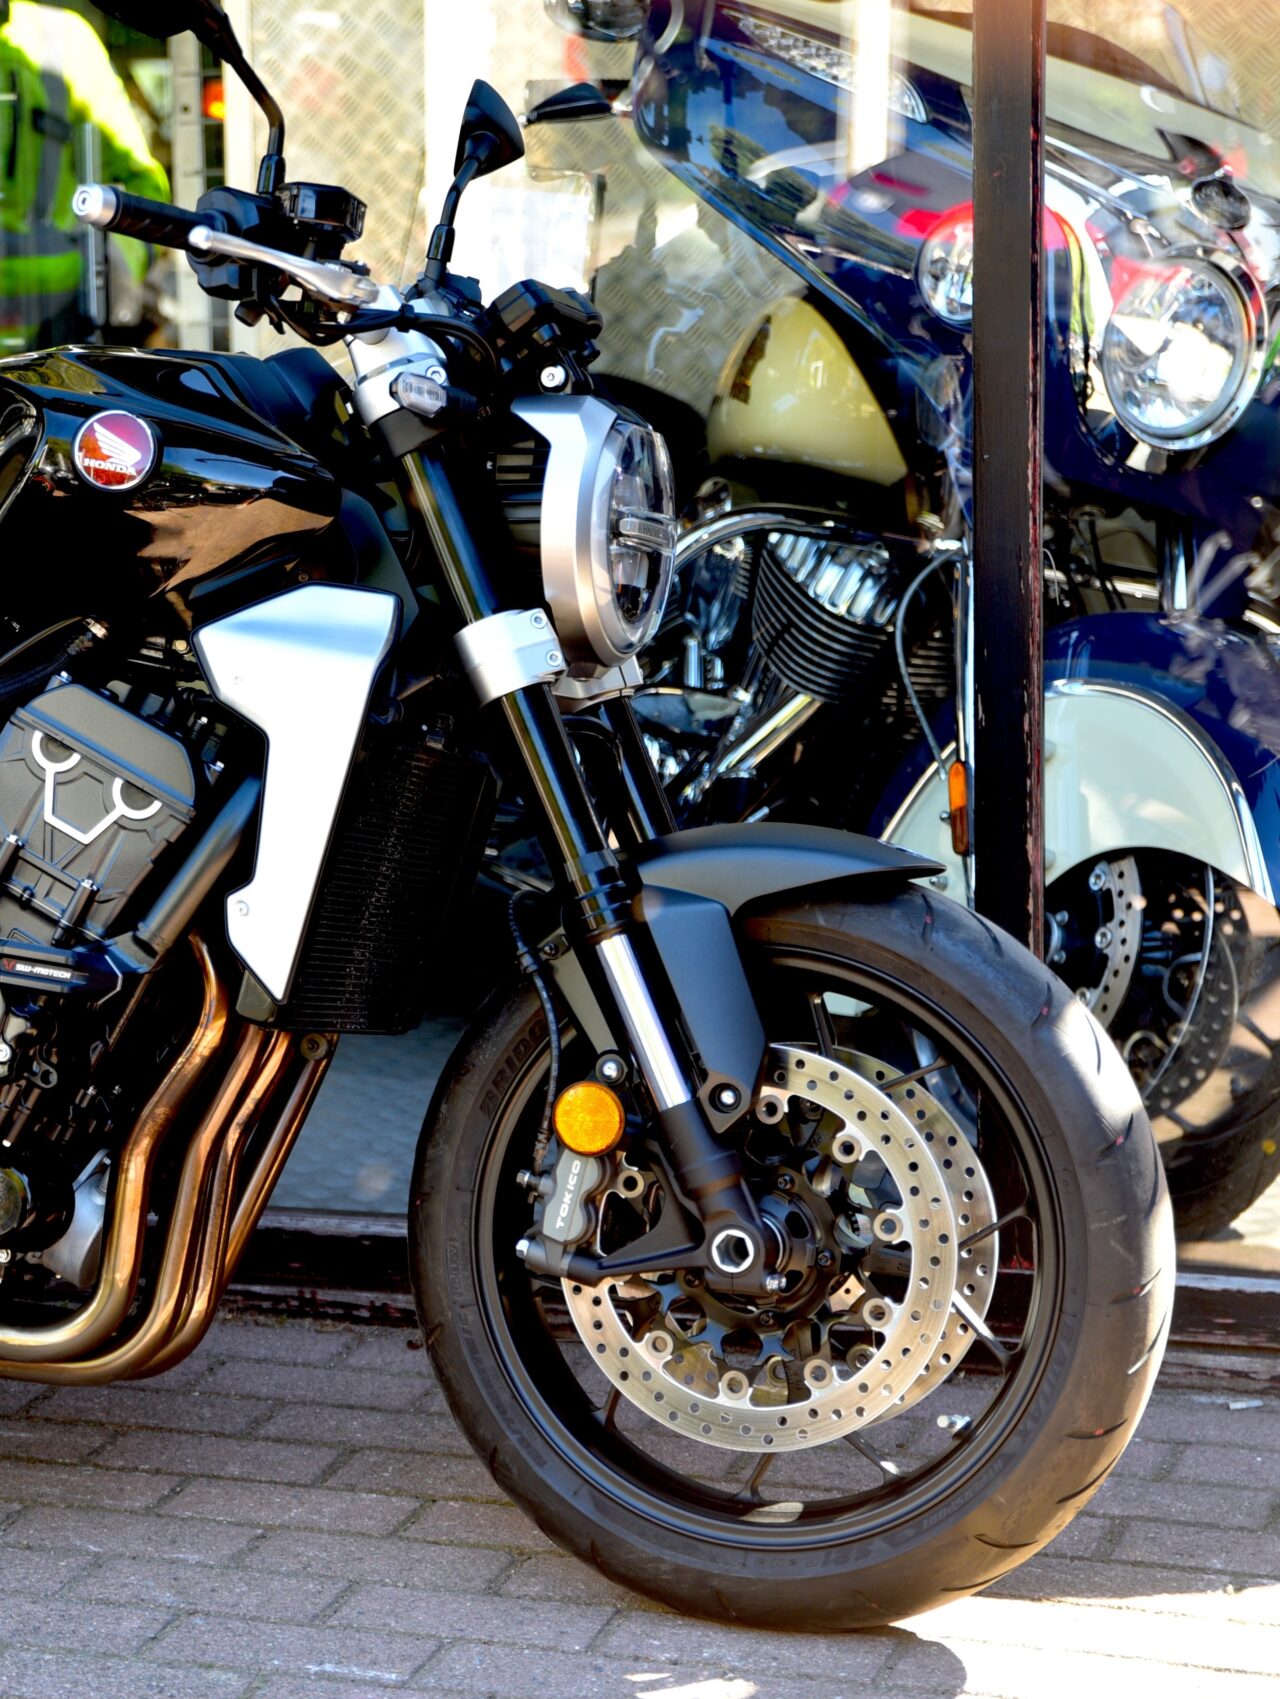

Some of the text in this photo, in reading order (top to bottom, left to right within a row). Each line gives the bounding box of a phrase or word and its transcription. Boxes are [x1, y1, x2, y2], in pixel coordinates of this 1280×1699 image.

[84, 457, 137, 476] HONDA
[15, 963, 72, 980] SW-MOTECH
[555, 1159, 581, 1230] TOKICO
